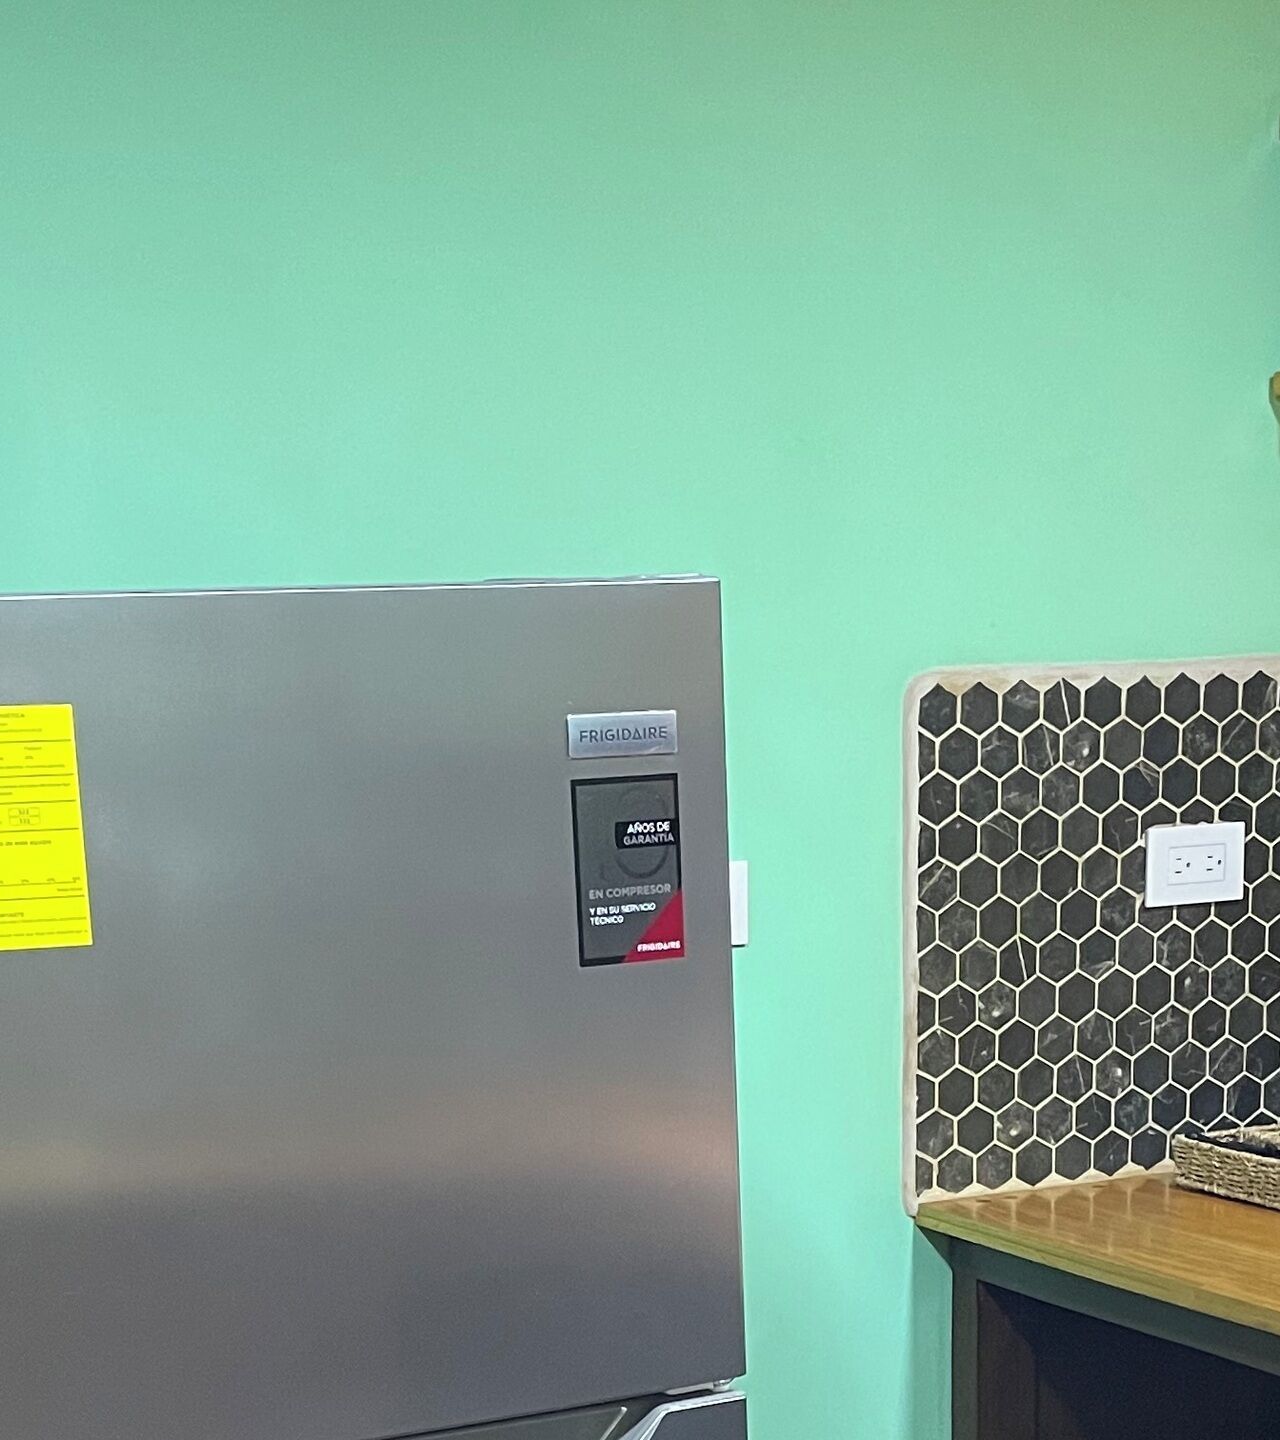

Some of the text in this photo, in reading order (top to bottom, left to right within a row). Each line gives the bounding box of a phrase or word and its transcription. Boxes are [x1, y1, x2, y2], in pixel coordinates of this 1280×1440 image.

[579, 726, 668, 743] FRIGIDAIRE
[626, 821, 671, 834] AÑOS DE
[589, 884, 671, 900] EN COMPRESOR
[589, 907, 596, 916] Y
